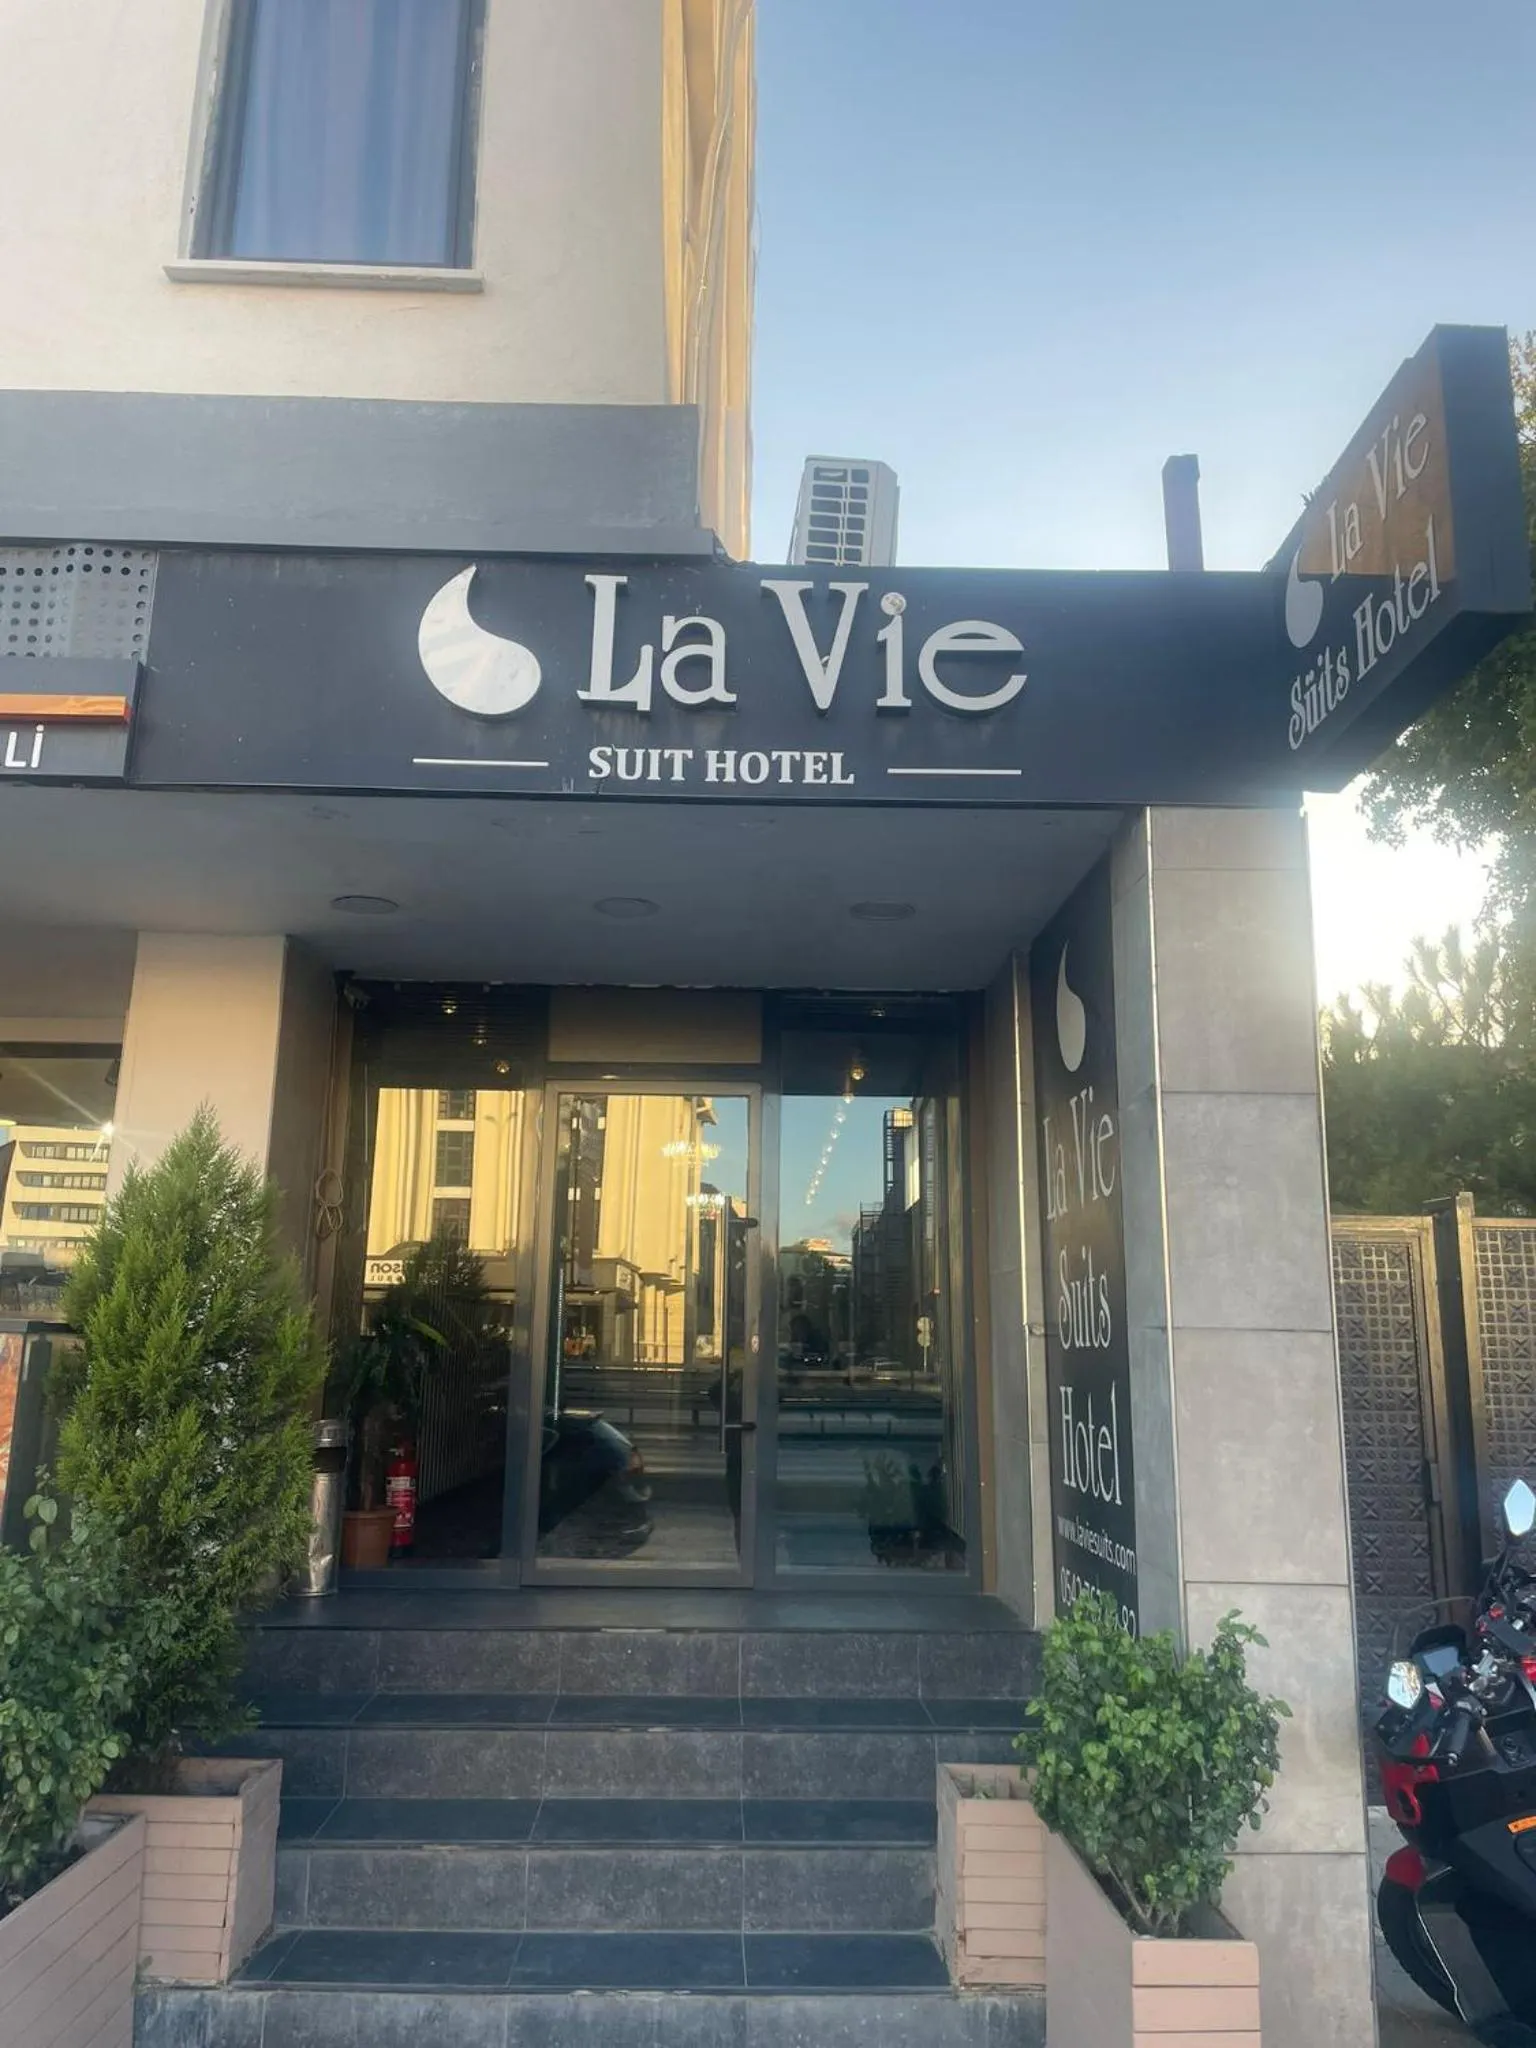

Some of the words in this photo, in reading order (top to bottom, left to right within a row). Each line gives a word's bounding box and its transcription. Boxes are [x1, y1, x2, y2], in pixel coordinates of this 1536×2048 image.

[1327, 498, 1364, 584] La
[1366, 412, 1429, 521] Vie
[576, 574, 738, 712] La
[760, 579, 1028, 712] Vie
[1353, 513, 1441, 682] Hotel
[588, 746, 694, 781] SUIT
[704, 750, 855, 785] HOTEL
[1043, 1117, 1068, 1222] La
[1069, 1085, 1115, 1209] Vie
[1058, 1245, 1112, 1350] Suits
[1059, 1379, 1123, 1506] Hotel
[1057, 1515, 1137, 1576] www.laviesuits.com
